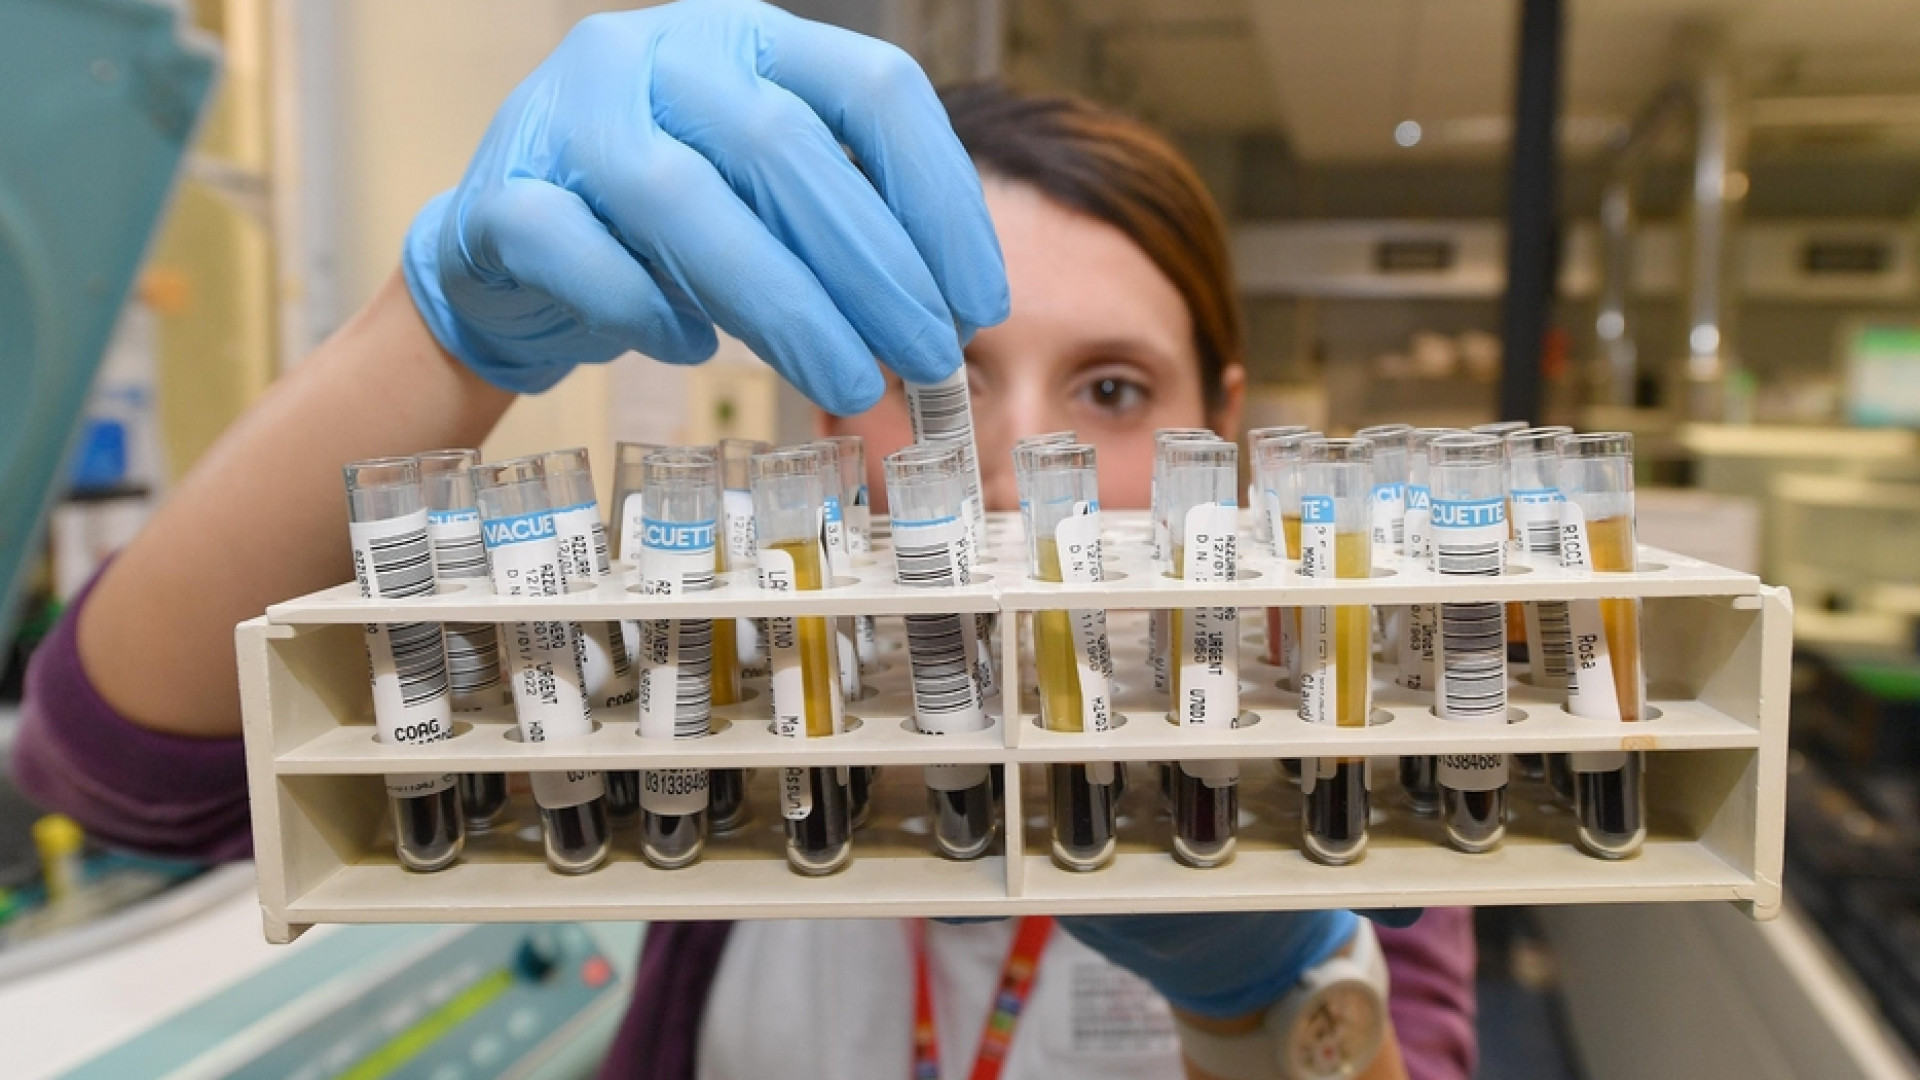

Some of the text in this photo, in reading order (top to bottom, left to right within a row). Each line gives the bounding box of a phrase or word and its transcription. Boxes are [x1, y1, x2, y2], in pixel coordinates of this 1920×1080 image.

[643, 525, 714, 546] CUETT
[1577, 635, 1598, 669] Rosa
[394, 718, 440, 742] COAG
